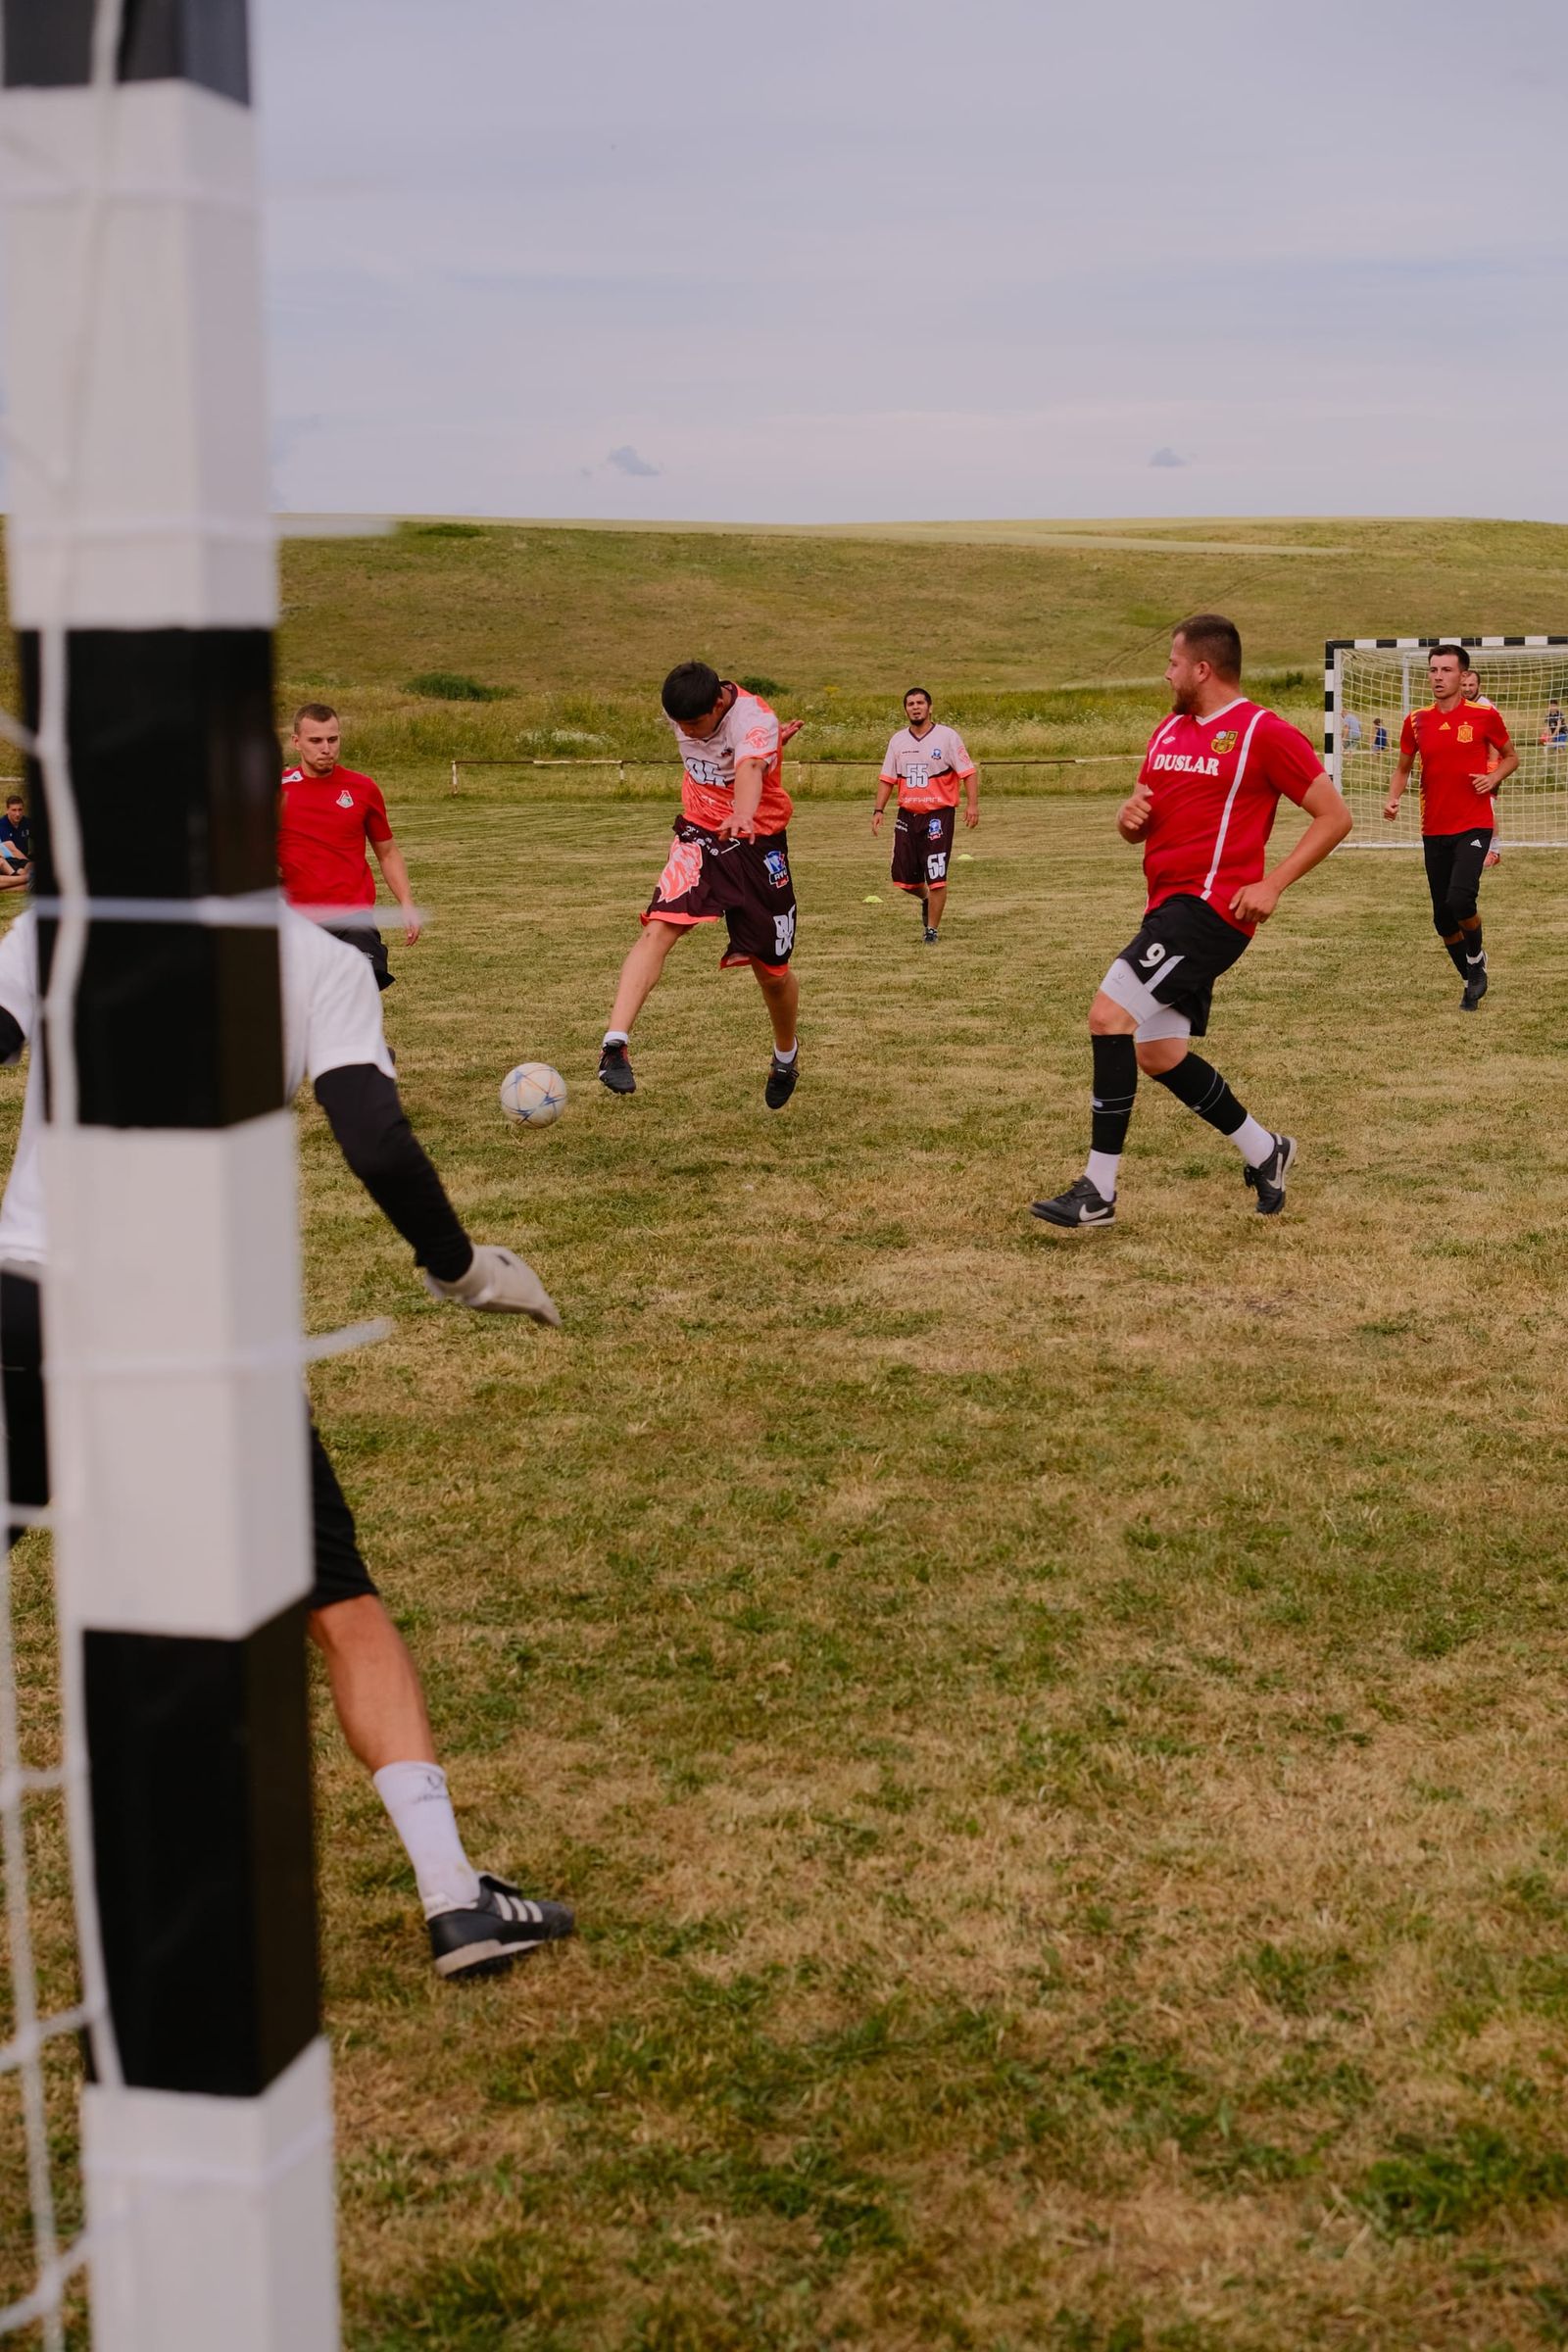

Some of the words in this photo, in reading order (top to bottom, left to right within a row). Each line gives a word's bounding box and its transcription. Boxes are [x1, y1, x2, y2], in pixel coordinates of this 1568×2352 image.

[906, 763, 929, 789] 55
[1152, 754, 1220, 776] DUSLAR
[927, 852, 947, 880] 55
[1138, 942, 1166, 968] 9
